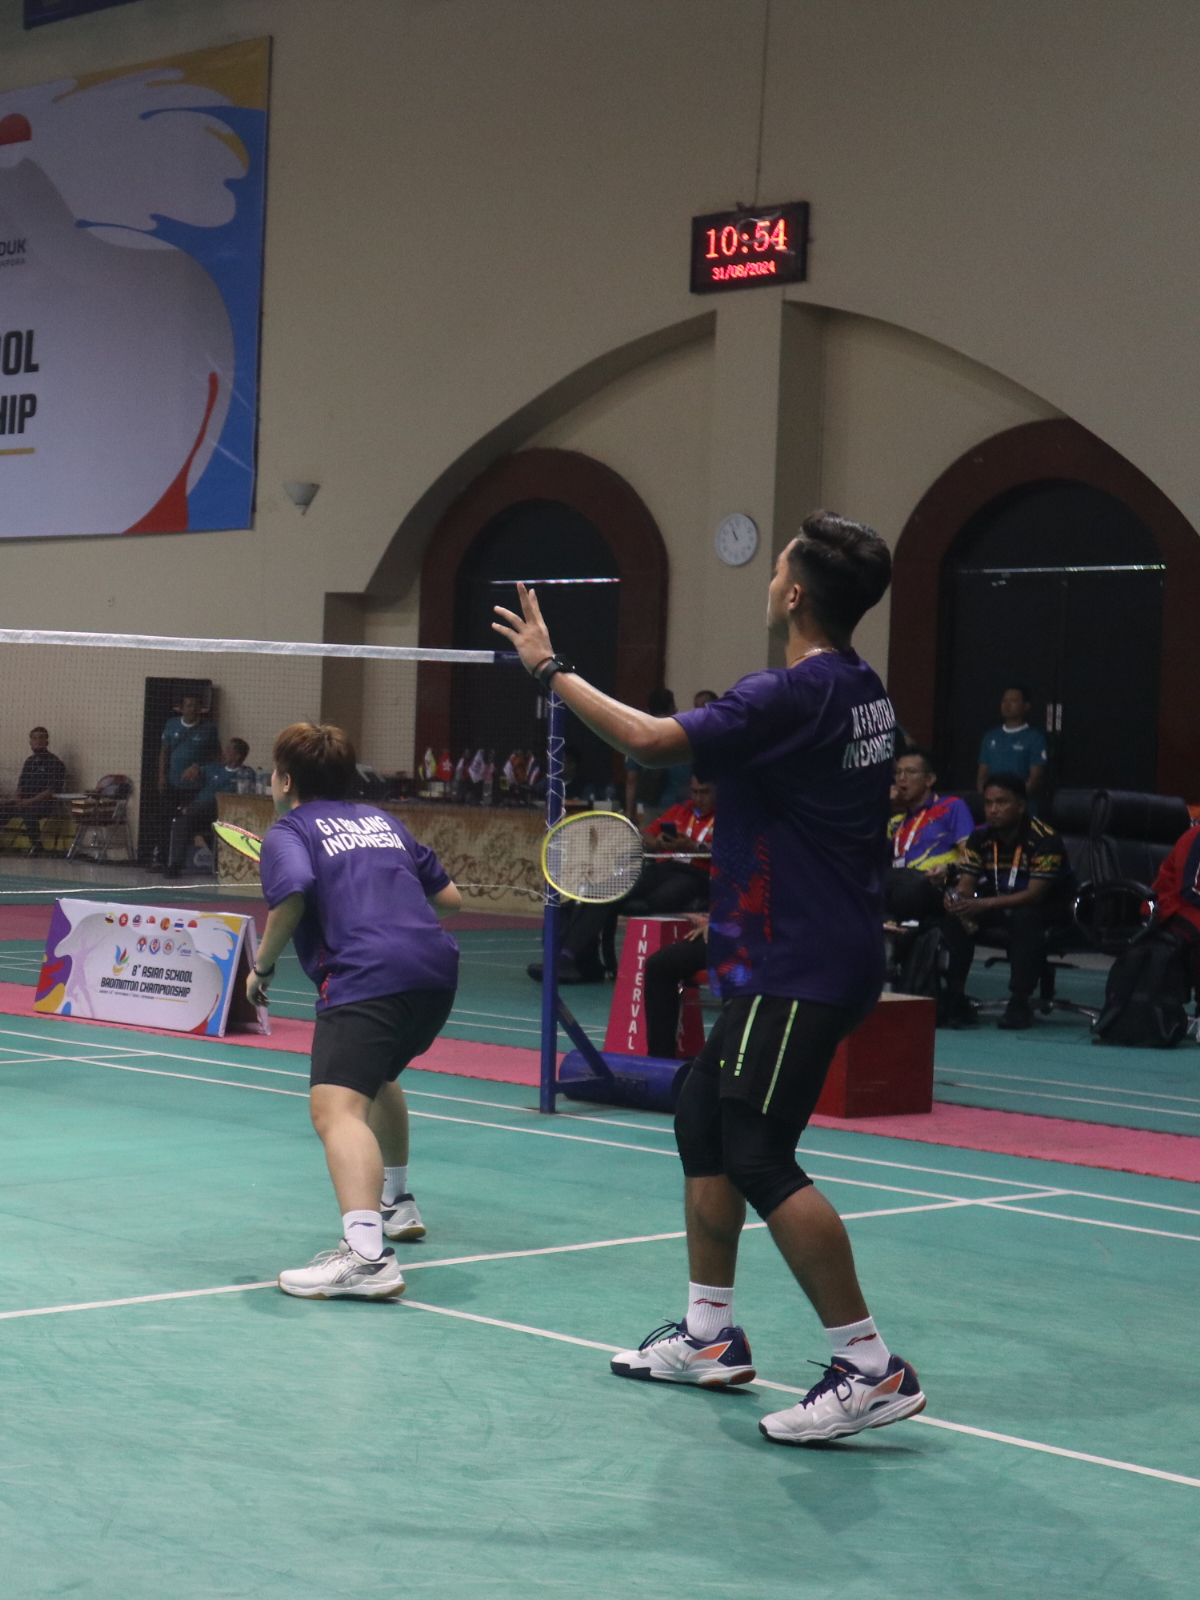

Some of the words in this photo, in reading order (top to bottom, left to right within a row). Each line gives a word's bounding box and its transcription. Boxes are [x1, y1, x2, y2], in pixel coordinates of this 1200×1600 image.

[705, 218, 787, 258] 10:54
[711, 260, 776, 280] 31/08/2024
[321, 831, 407, 857] INDONESIA
[142, 966, 165, 980] ASIAN
[164, 968, 193, 983] SCHOOL
[100, 977, 140, 992] BADMINTON
[140, 982, 191, 998] CHAMPIONSHIP
[628, 924, 648, 1050] INTERVAL
